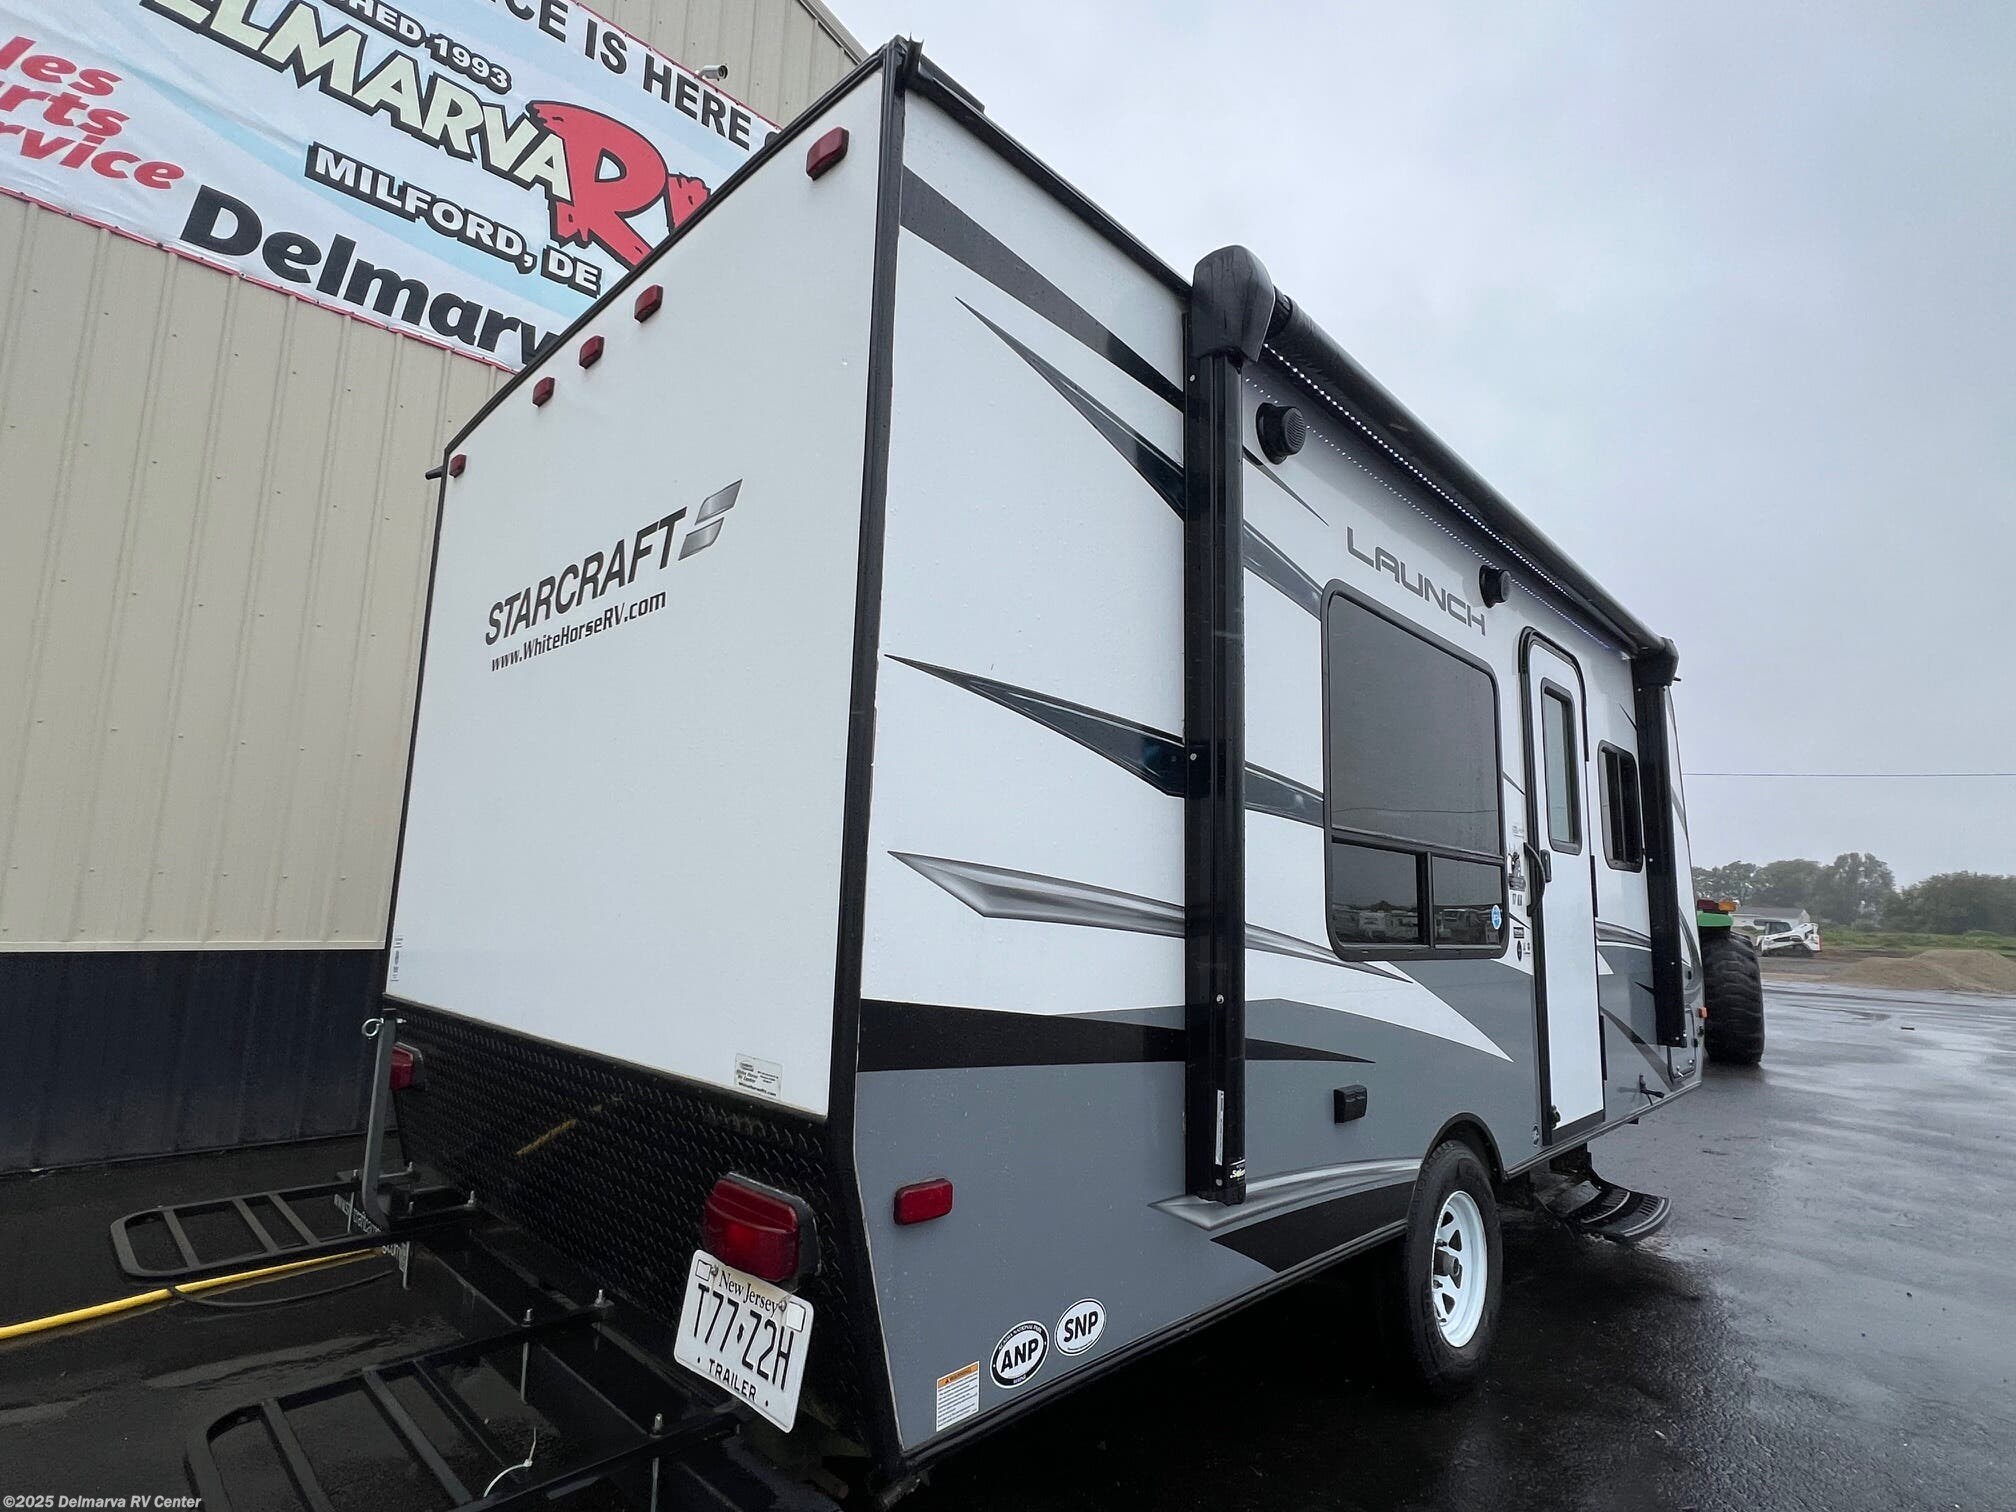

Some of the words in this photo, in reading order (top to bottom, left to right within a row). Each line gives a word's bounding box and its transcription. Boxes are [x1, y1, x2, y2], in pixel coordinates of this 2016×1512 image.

[433, 37, 508, 89] 1993
[584, 18, 628, 74] IS
[643, 53, 752, 151] HERE
[0, 81, 130, 137] rts
[312, 145, 536, 269] MILFORD,
[547, 249, 600, 294] DE
[485, 505, 688, 646] STARCRAFT
[1346, 526, 1486, 637] LAUNCH
[491, 591, 667, 672] www.WhiteHorseRV.com
[719, 1270, 745, 1298] New
[745, 1282, 779, 1318] Jersey
[1063, 1310, 1099, 1343] SNP
[709, 1358, 758, 1402] TRAILER
[1000, 1337, 1039, 1374] ANP
